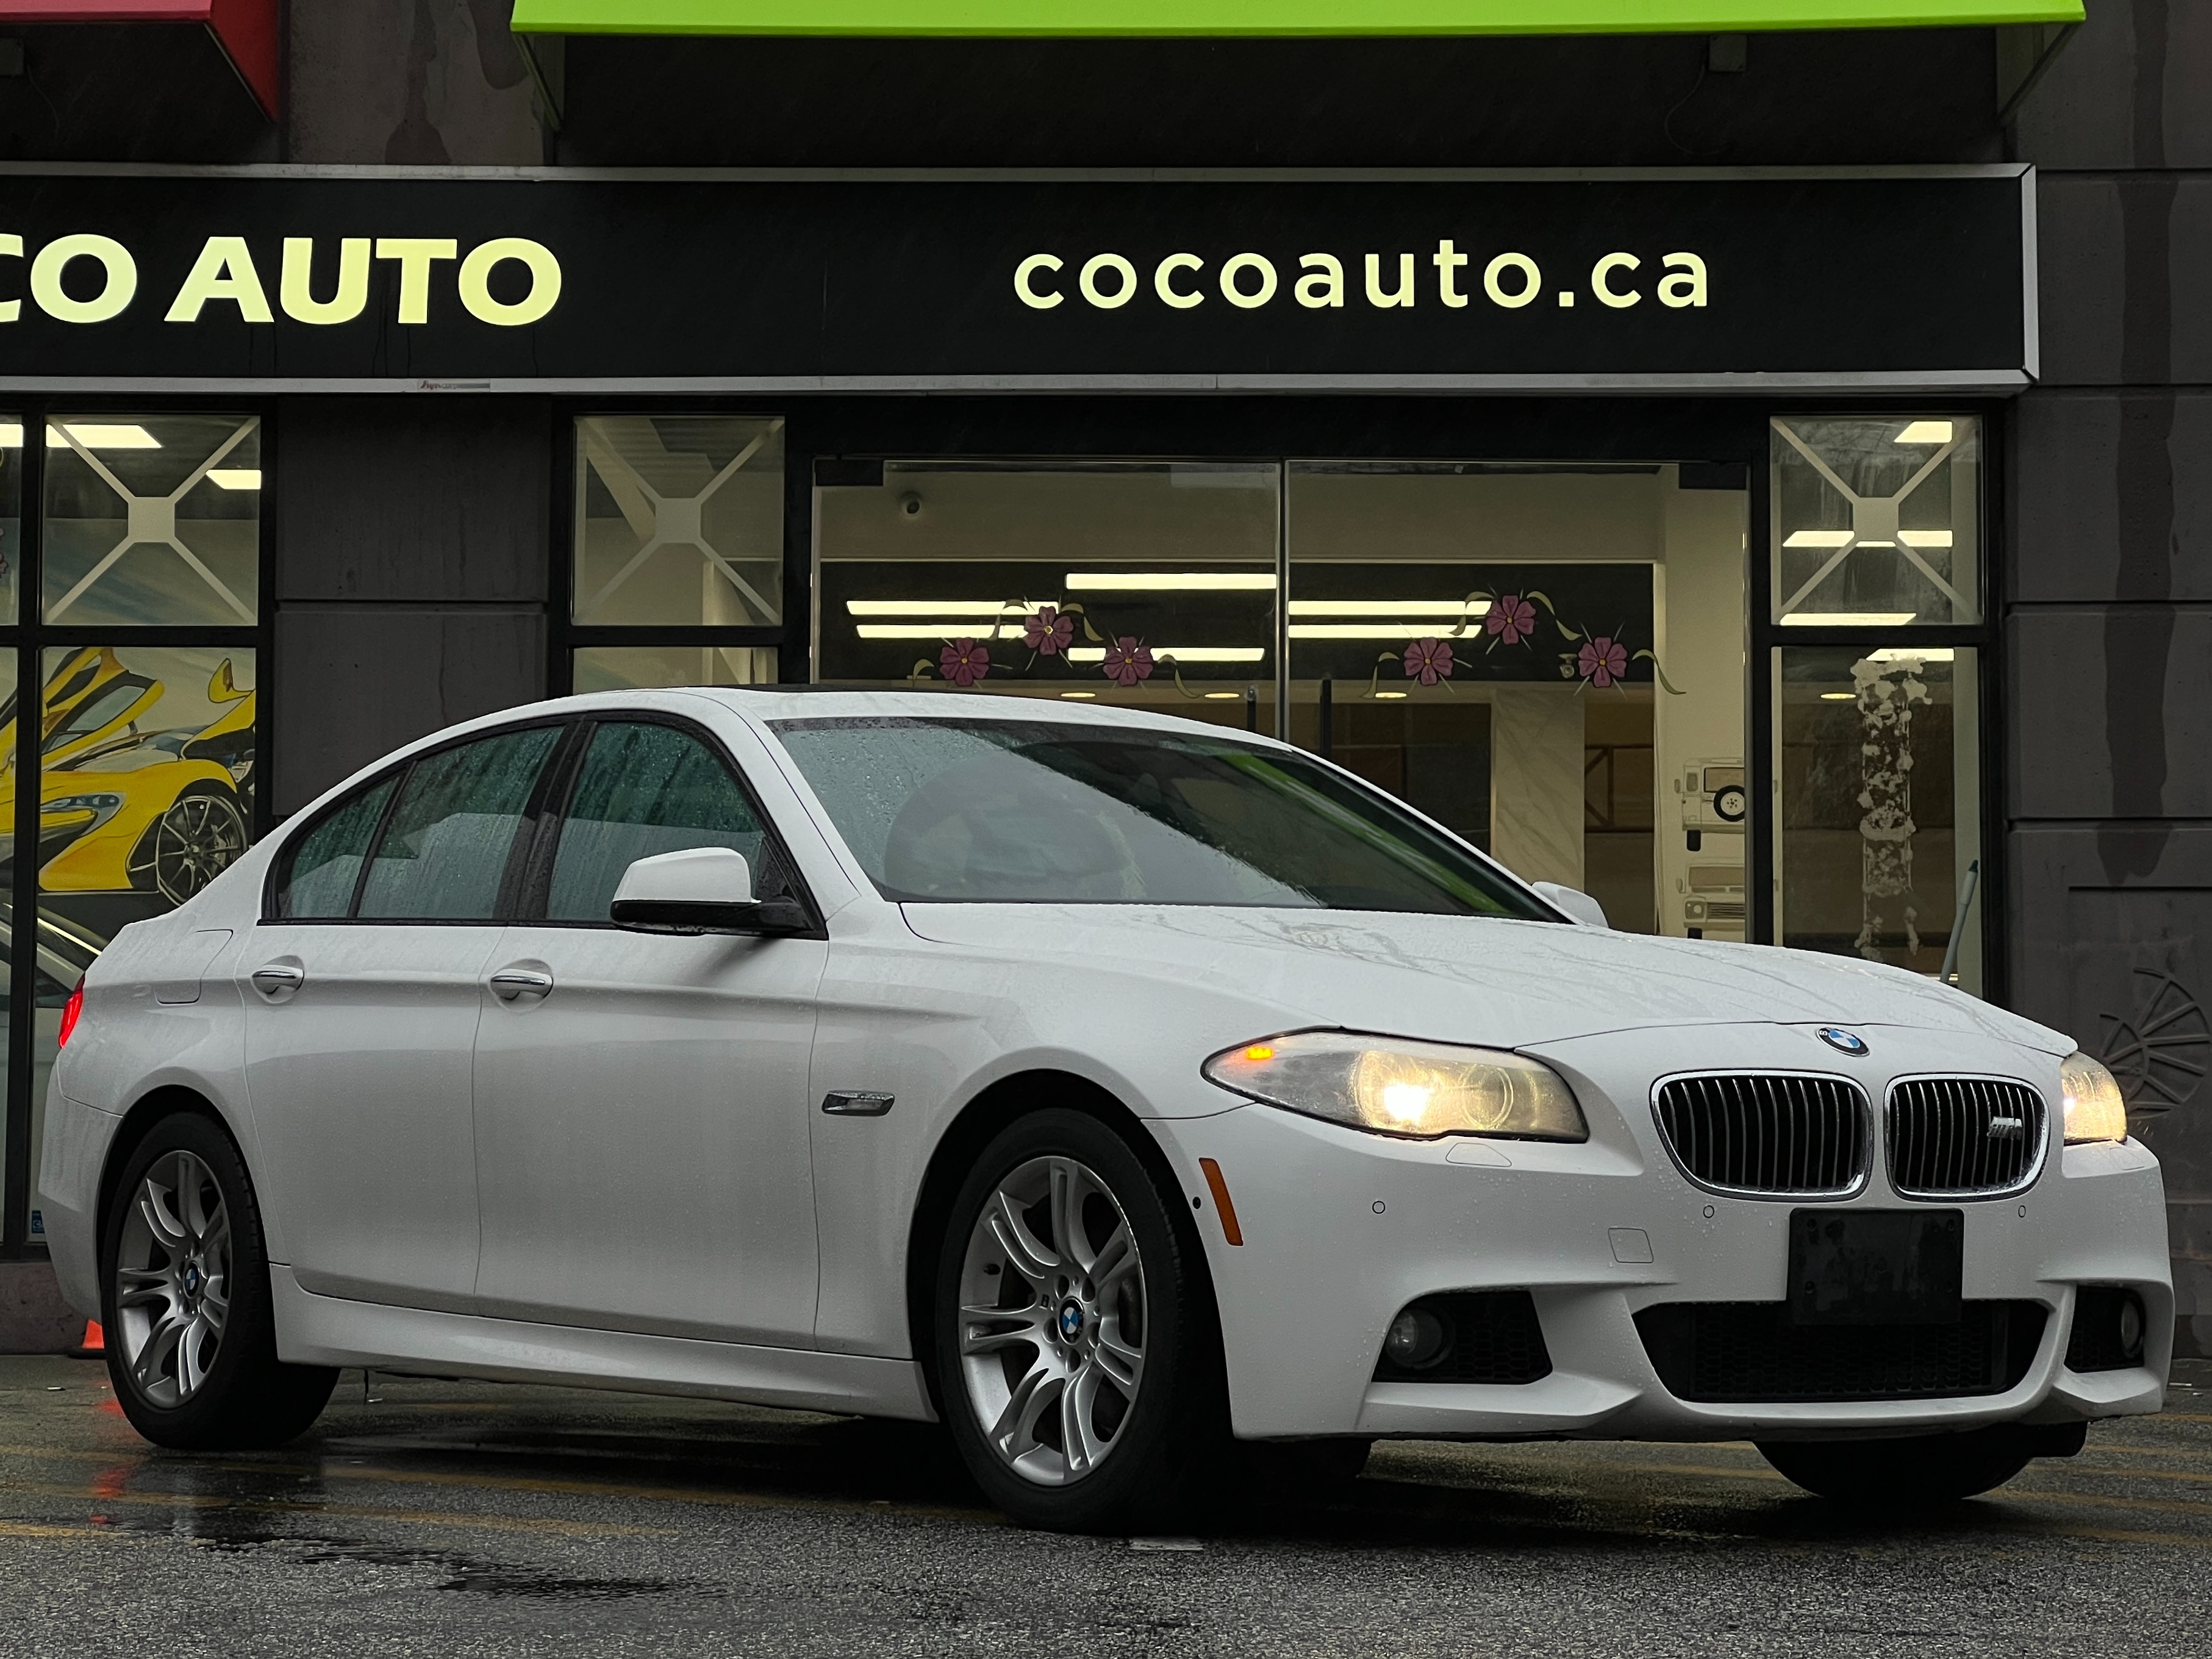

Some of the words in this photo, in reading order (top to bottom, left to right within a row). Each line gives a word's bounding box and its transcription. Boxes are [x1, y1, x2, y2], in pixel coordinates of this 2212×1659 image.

[0, 234, 137, 323] O
[164, 237, 562, 326] AUTO
[1014, 240, 1708, 309] cocoauto.ca
